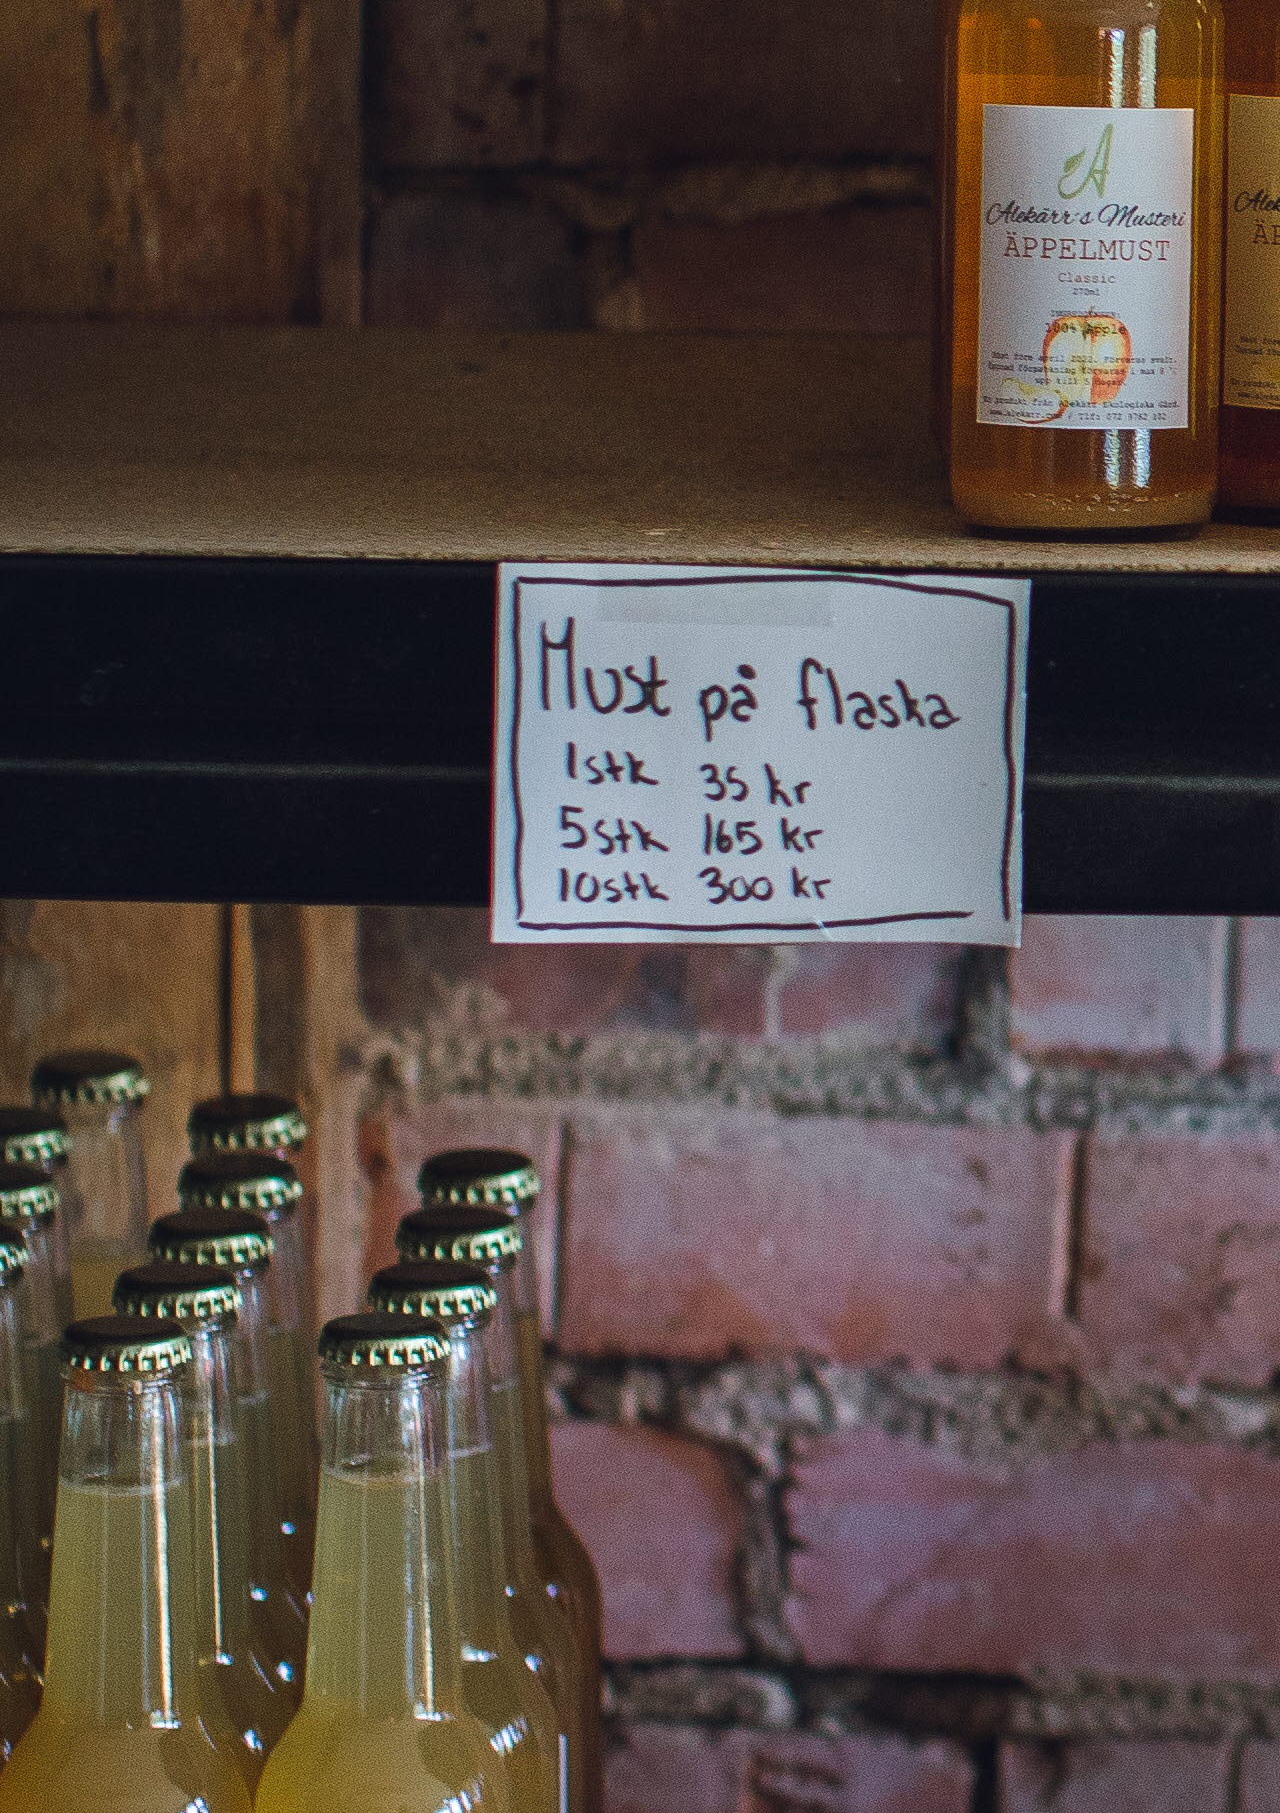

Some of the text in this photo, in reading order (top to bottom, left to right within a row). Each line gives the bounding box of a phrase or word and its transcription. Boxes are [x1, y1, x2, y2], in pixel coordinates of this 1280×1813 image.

[1098, 203, 1186, 228] Musteri
[1004, 231, 1170, 261] ÄPPELMUST
[1058, 272, 1116, 285] Classic
[540, 617, 961, 742] Must på flaska
[700, 763, 750, 802] 35
[765, 763, 813, 807] kr
[704, 813, 763, 856] 165
[781, 816, 825, 855] kr
[699, 867, 774, 905] 300
[790, 866, 832, 901] kr
